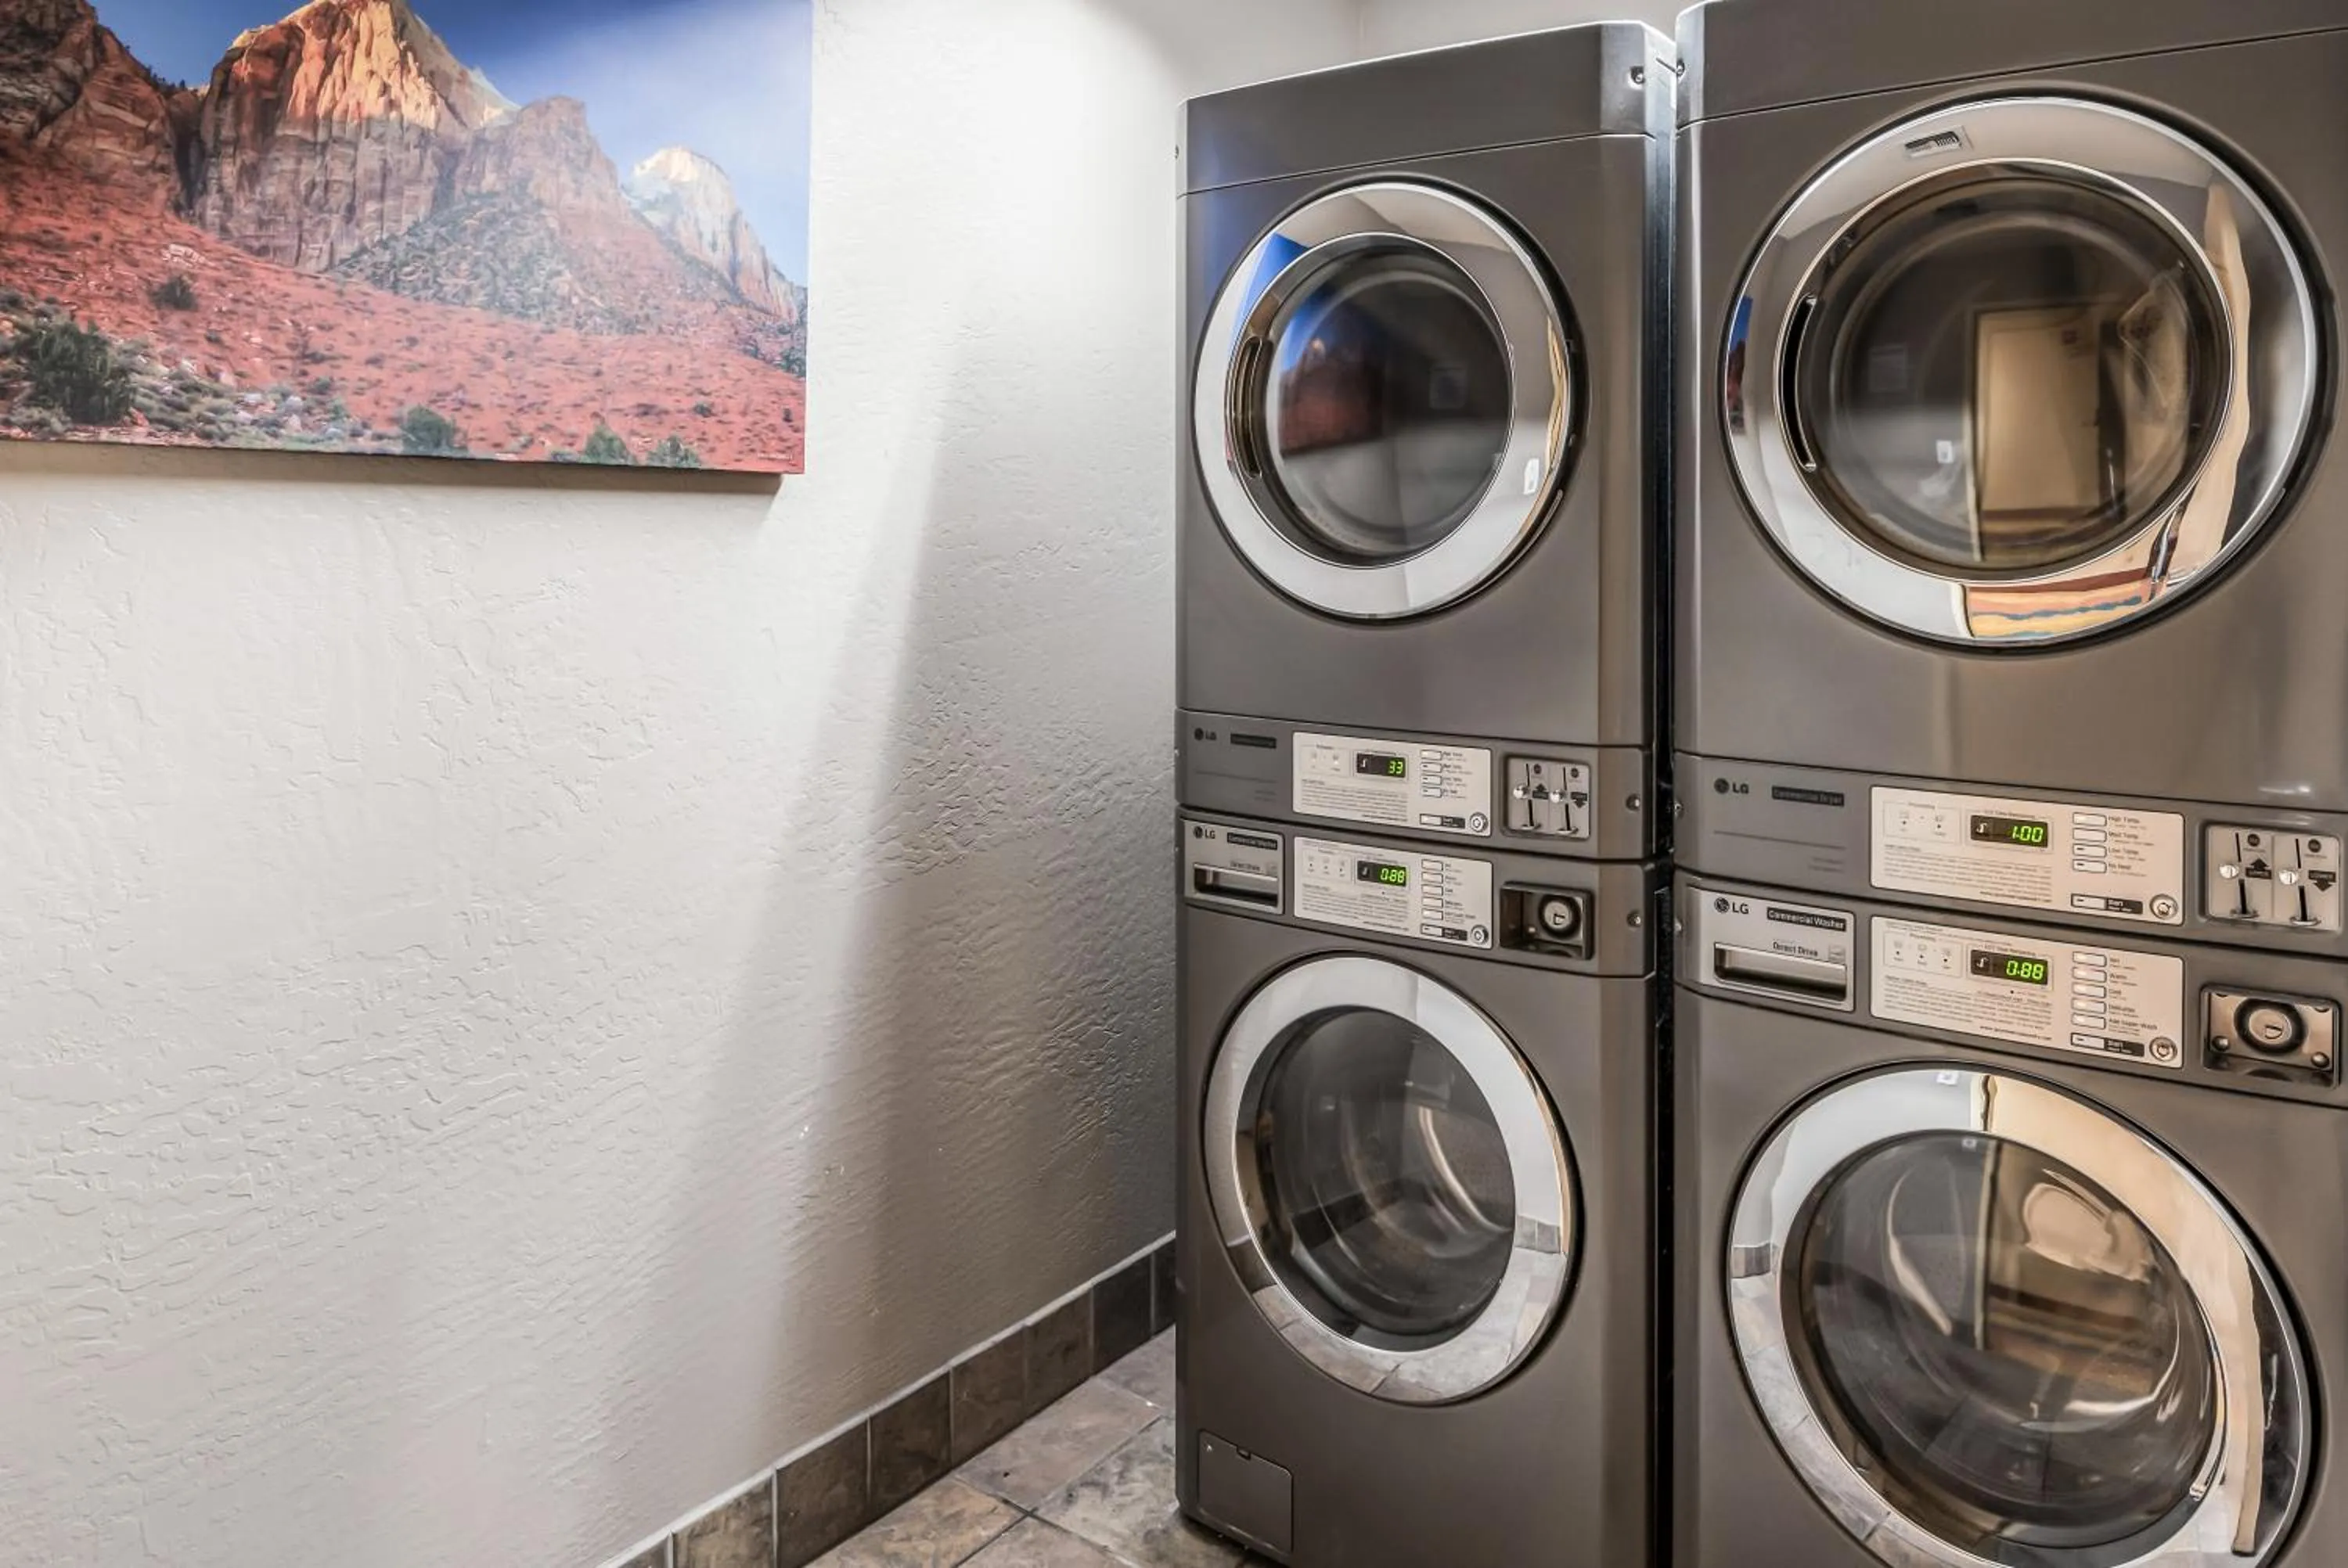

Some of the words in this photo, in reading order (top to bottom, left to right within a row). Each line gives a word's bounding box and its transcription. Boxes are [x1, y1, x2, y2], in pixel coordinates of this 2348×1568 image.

[1388, 761, 1403, 774] 33
[1732, 783, 1749, 794] LG
[1732, 902, 1749, 915] LG
[1768, 910, 1814, 925] Commercial
[1814, 916, 1844, 929] Washer
